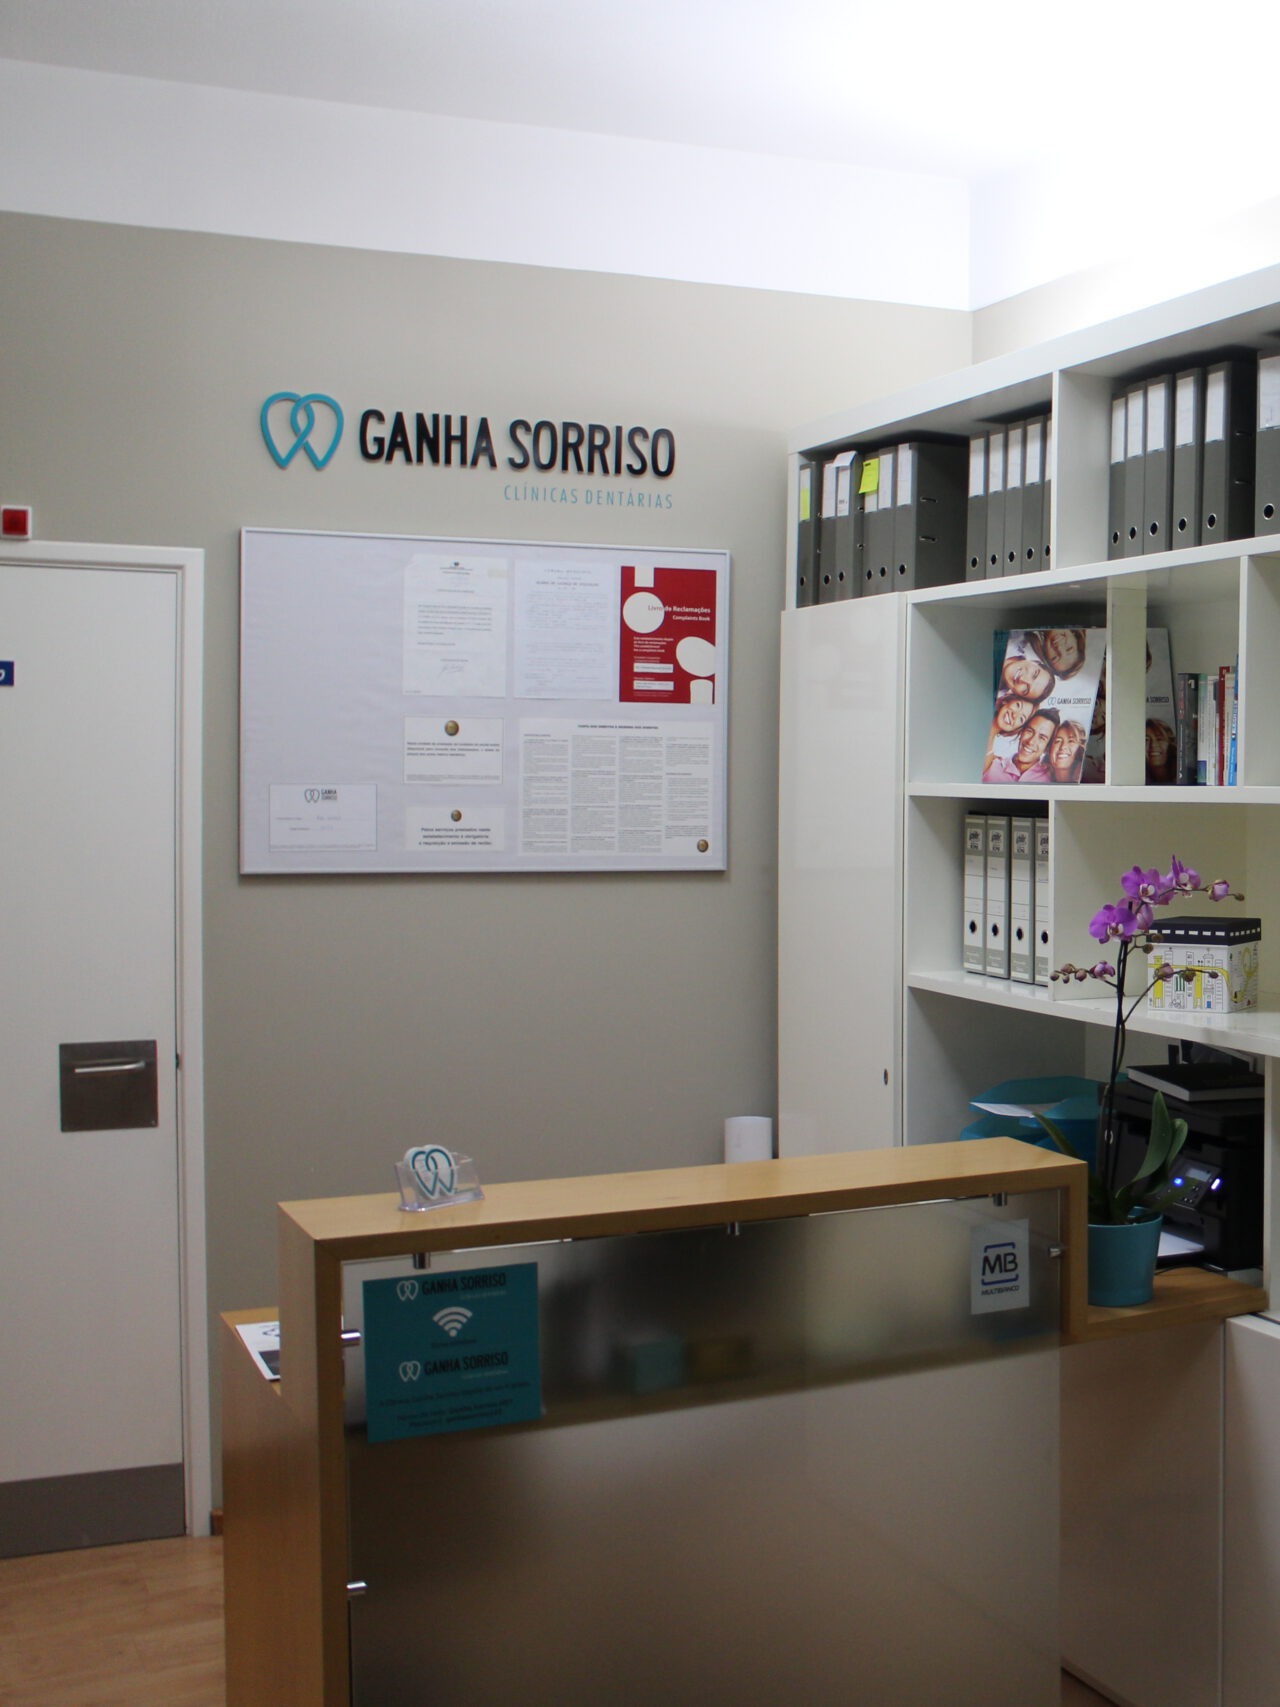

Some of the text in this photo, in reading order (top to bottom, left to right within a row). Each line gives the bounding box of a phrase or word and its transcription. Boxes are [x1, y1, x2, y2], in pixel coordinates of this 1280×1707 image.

[359, 409, 676, 478] GANHA SORRISO
[504, 482, 673, 509] CLÍNICAS DENTÁRIAS
[982, 1252, 1018, 1276] MB
[421, 1278, 458, 1295] GANHA
[460, 1272, 506, 1291] SORRISO
[424, 1357, 460, 1375] GANHA
[462, 1351, 508, 1370] SORRISO
